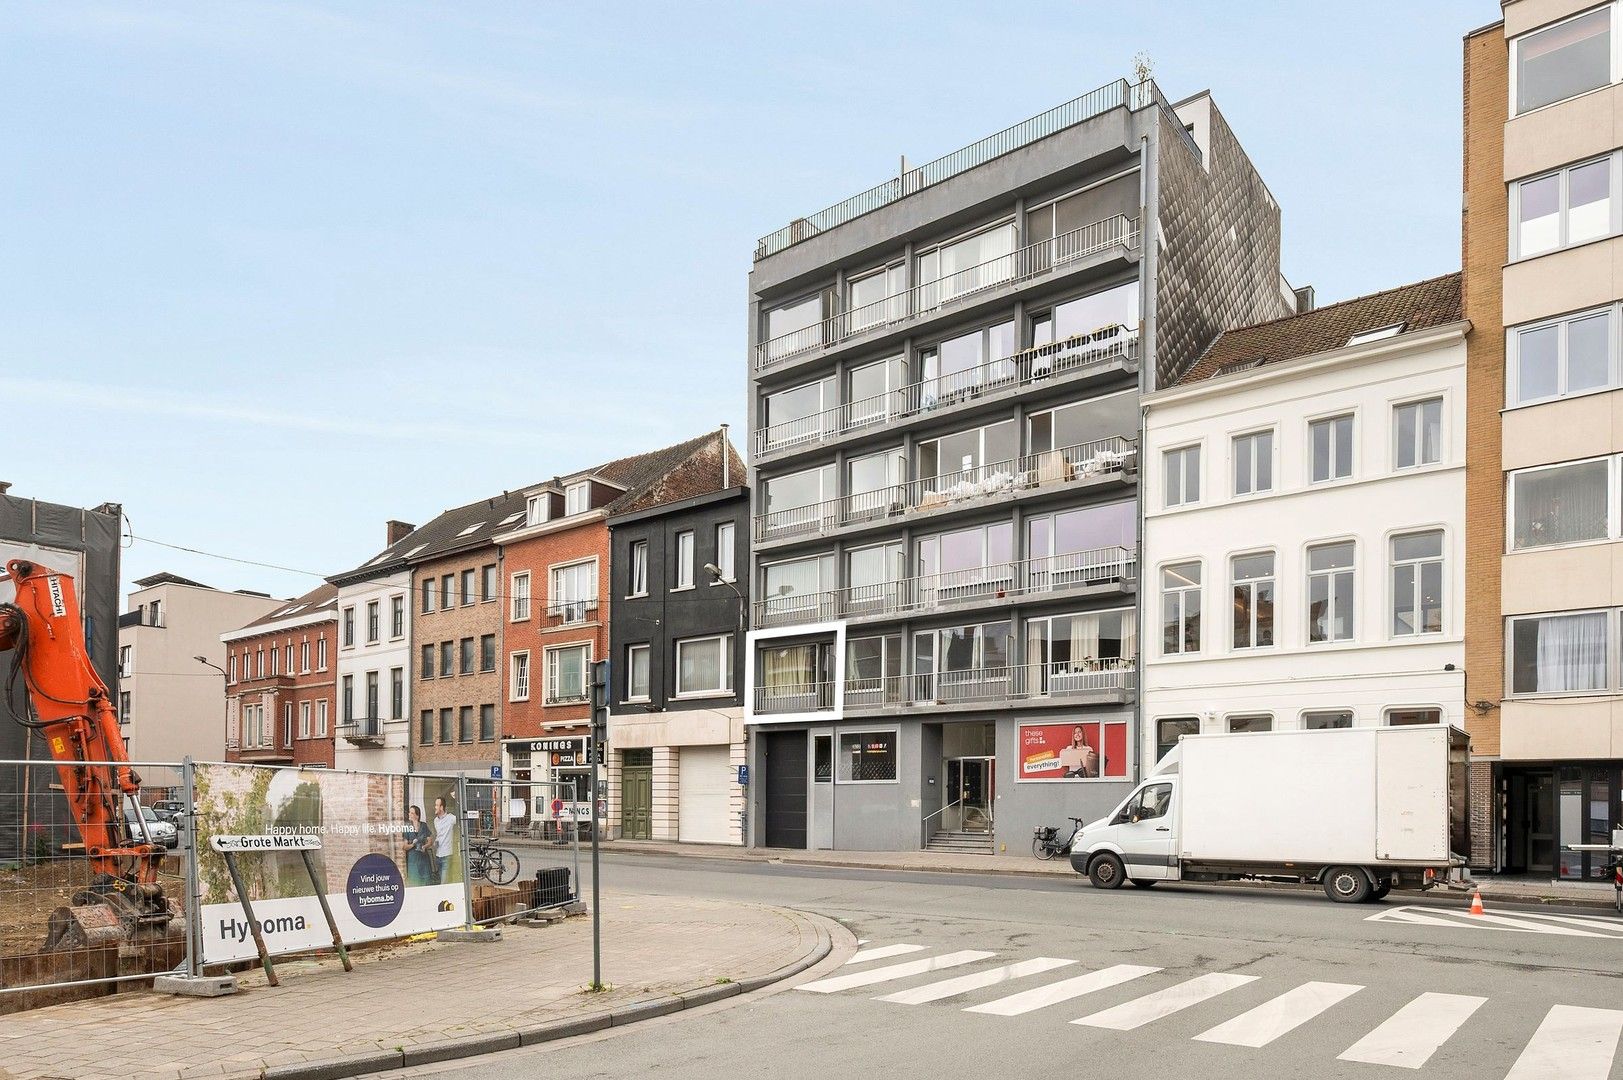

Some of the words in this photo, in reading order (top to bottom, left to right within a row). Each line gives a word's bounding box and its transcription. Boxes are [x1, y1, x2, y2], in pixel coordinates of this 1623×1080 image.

[50, 578, 63, 614] HITACHI
[530, 741, 572, 751] KONINGS
[266, 824, 297, 836] Happy
[300, 824, 328, 834] home.
[331, 823, 360, 836] Happy
[362, 823, 377, 834] life.
[378, 822, 417, 835] Hyboma.
[241, 837, 271, 848] Grote
[274, 835, 305, 847] Markt
[361, 874, 374, 882] Vind
[376, 874, 390, 883] jouw
[352, 886, 374, 894] nieuwe
[375, 884, 390, 892] thuis
[360, 894, 394, 905] hyboma.be
